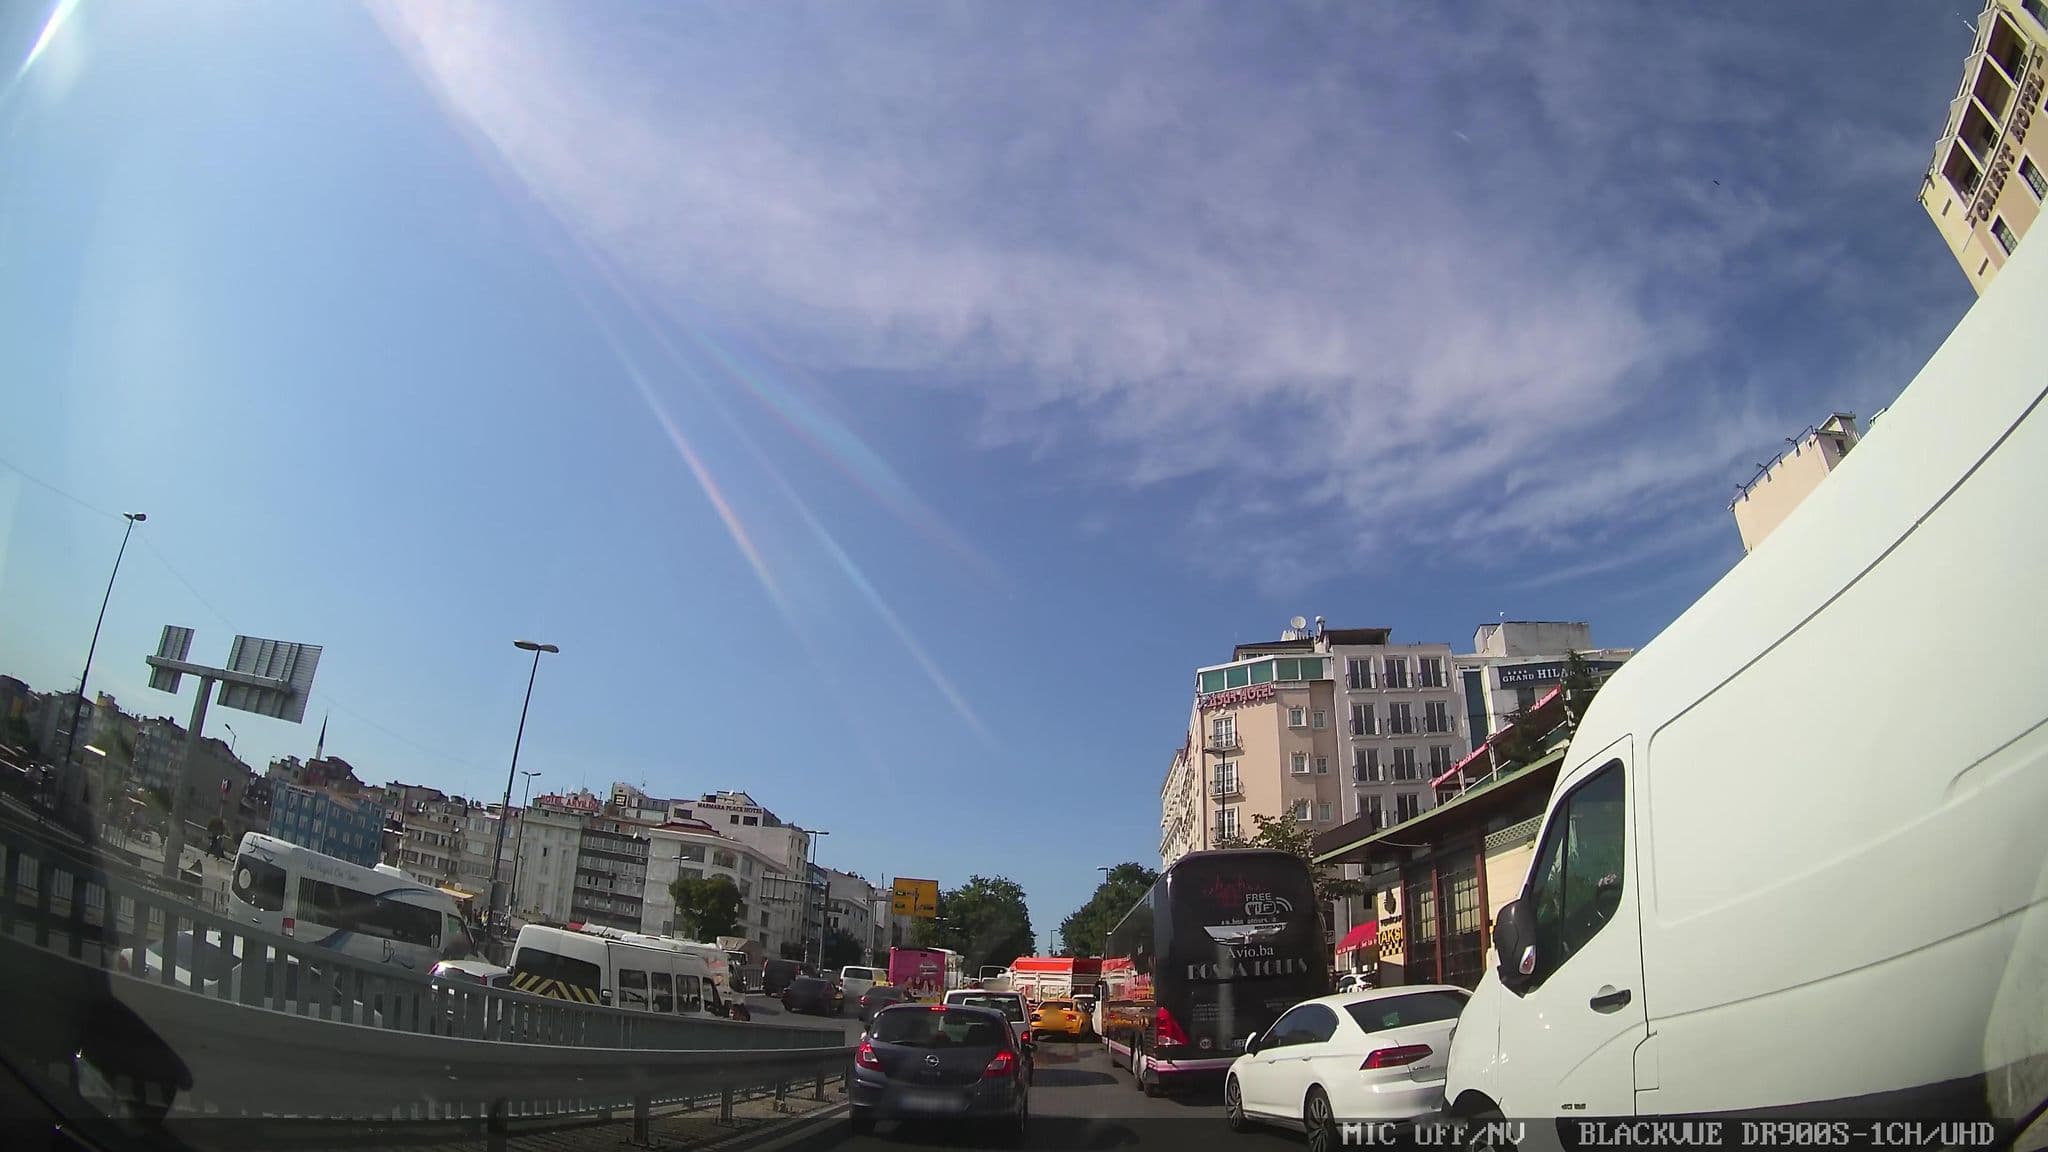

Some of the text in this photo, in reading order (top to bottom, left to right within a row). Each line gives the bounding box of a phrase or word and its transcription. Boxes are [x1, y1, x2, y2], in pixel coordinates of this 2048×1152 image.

[1976, 72, 2045, 222] ORIENT HOTEL
[1502, 672, 1535, 683] GRAND
[1239, 683, 1275, 702] HOTEL
[697, 802, 725, 811] MARMARA
[743, 807, 763, 815] HOTEL
[1245, 892, 1272, 902] FREE
[1376, 927, 1404, 946] TAKSI
[1228, 945, 1274, 959] Avio.ba
[1187, 963, 1249, 981] BOSA
